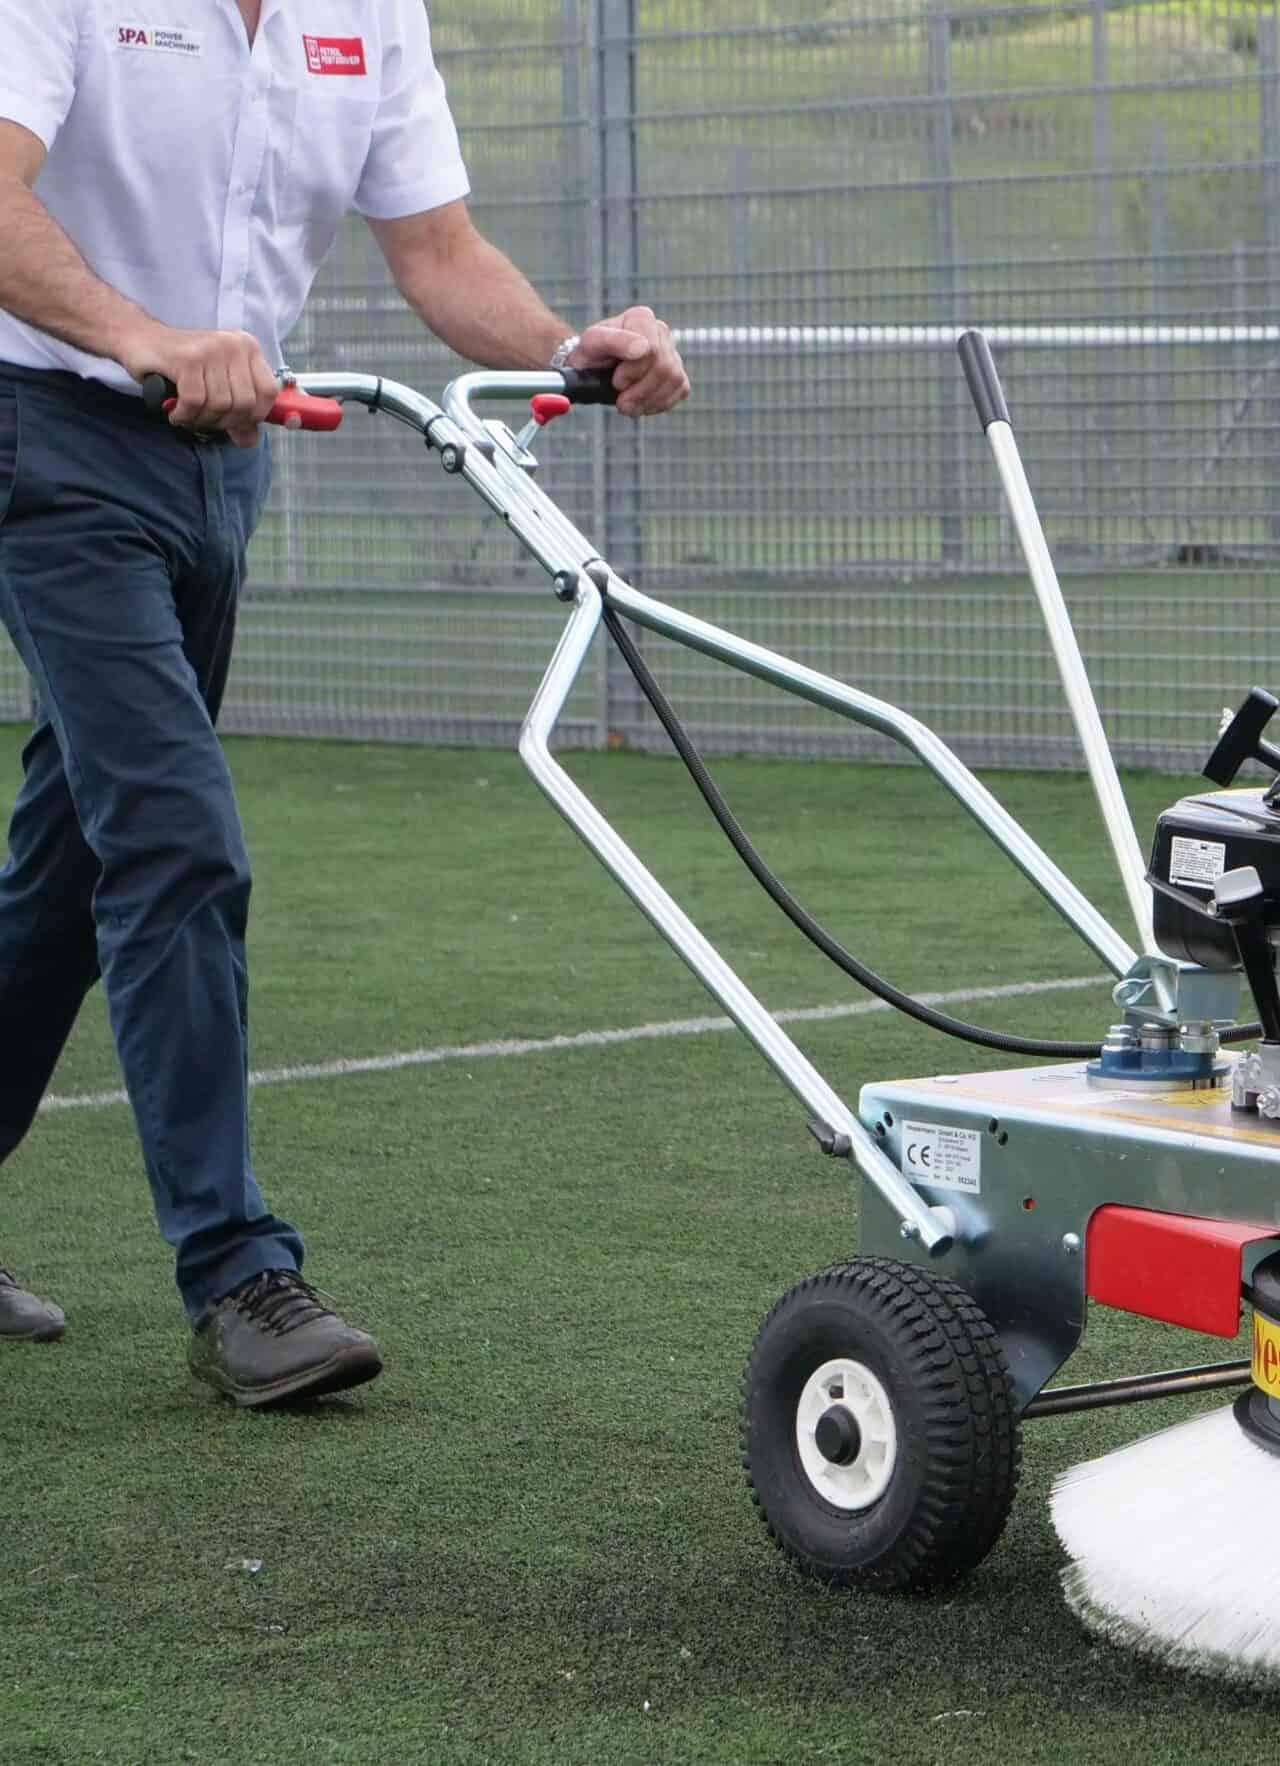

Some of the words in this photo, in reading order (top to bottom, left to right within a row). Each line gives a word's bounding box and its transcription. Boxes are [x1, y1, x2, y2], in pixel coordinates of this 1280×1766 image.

[118, 27, 148, 45] SPA
[155, 31, 182, 41] POWER
[155, 40, 200, 51] MACHINERY
[907, 1143, 930, 1167] CE
